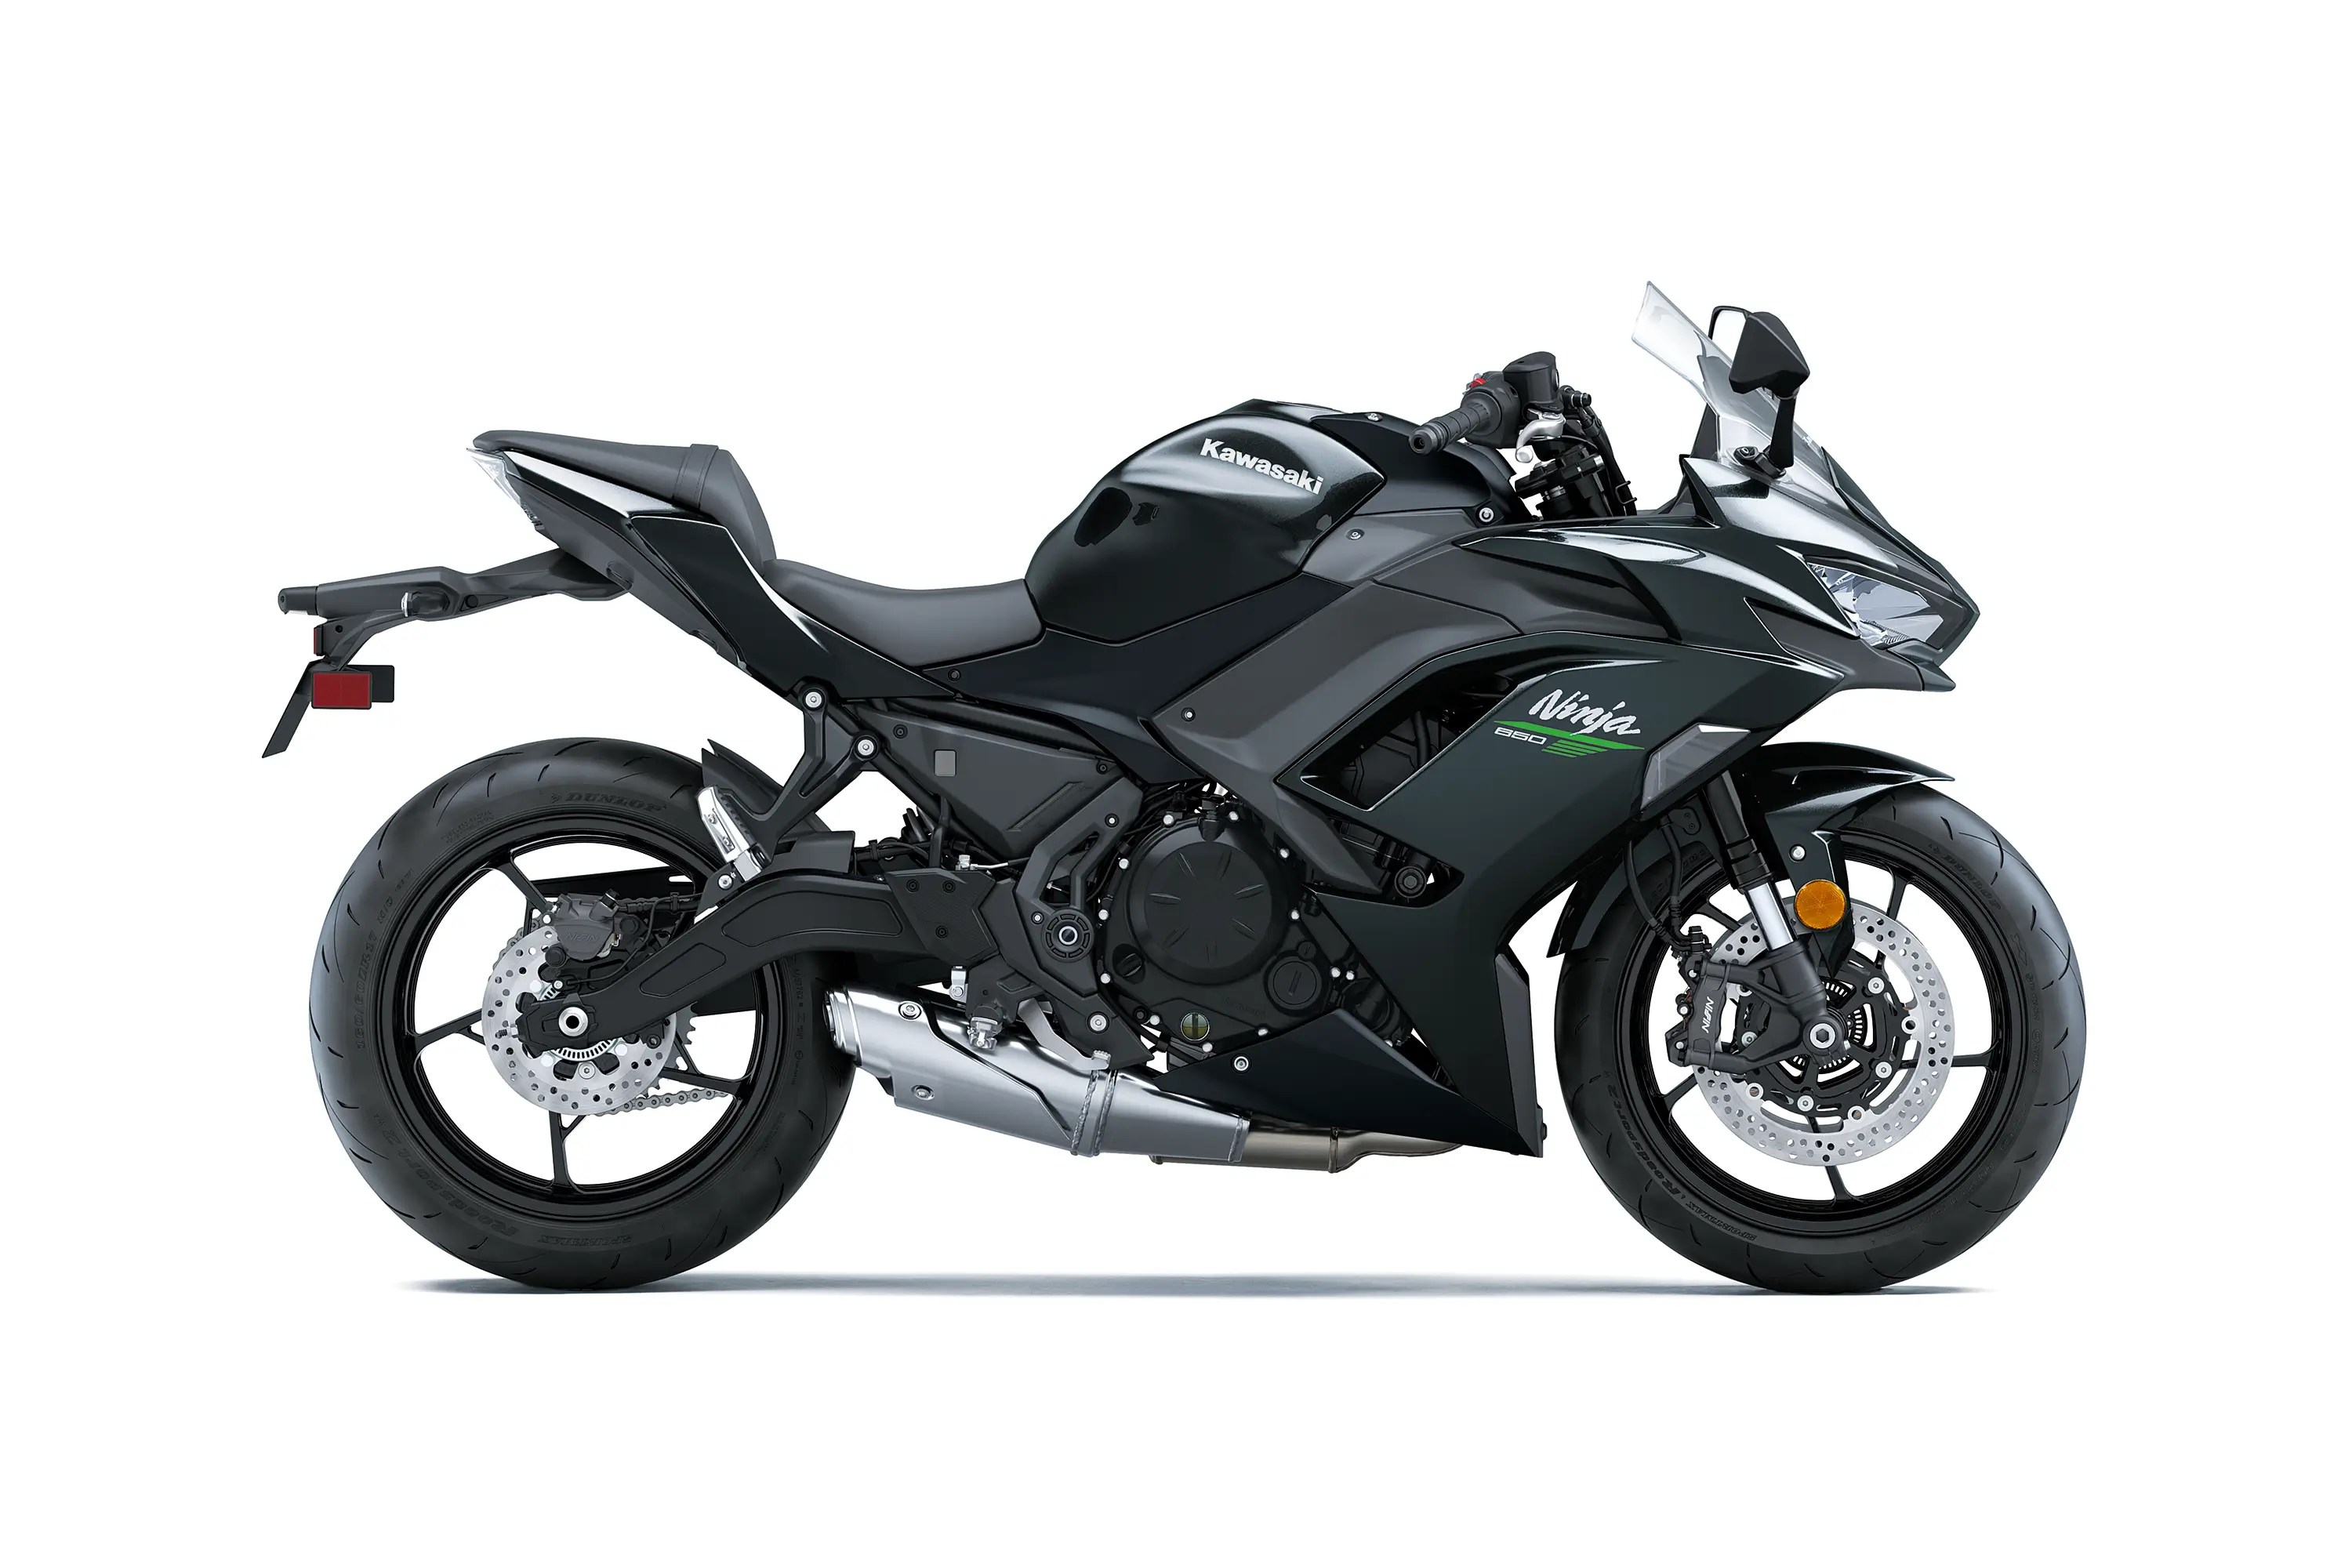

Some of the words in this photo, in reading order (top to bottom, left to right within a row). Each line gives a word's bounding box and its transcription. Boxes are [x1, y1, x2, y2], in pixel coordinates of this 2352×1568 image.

[1200, 437, 1323, 495] Kawasaki
[1529, 689, 1641, 735] Ninja
[1494, 727, 1547, 745] 650
[564, 792, 662, 812] DUNLOP
[1607, 1083, 1619, 1100] 2
[382, 1127, 402, 1145] 2
[1612, 1100, 1682, 1196] Roadsport
[397, 1147, 519, 1237] Roadsport
[1685, 1200, 1757, 1242] SPORTMAX
